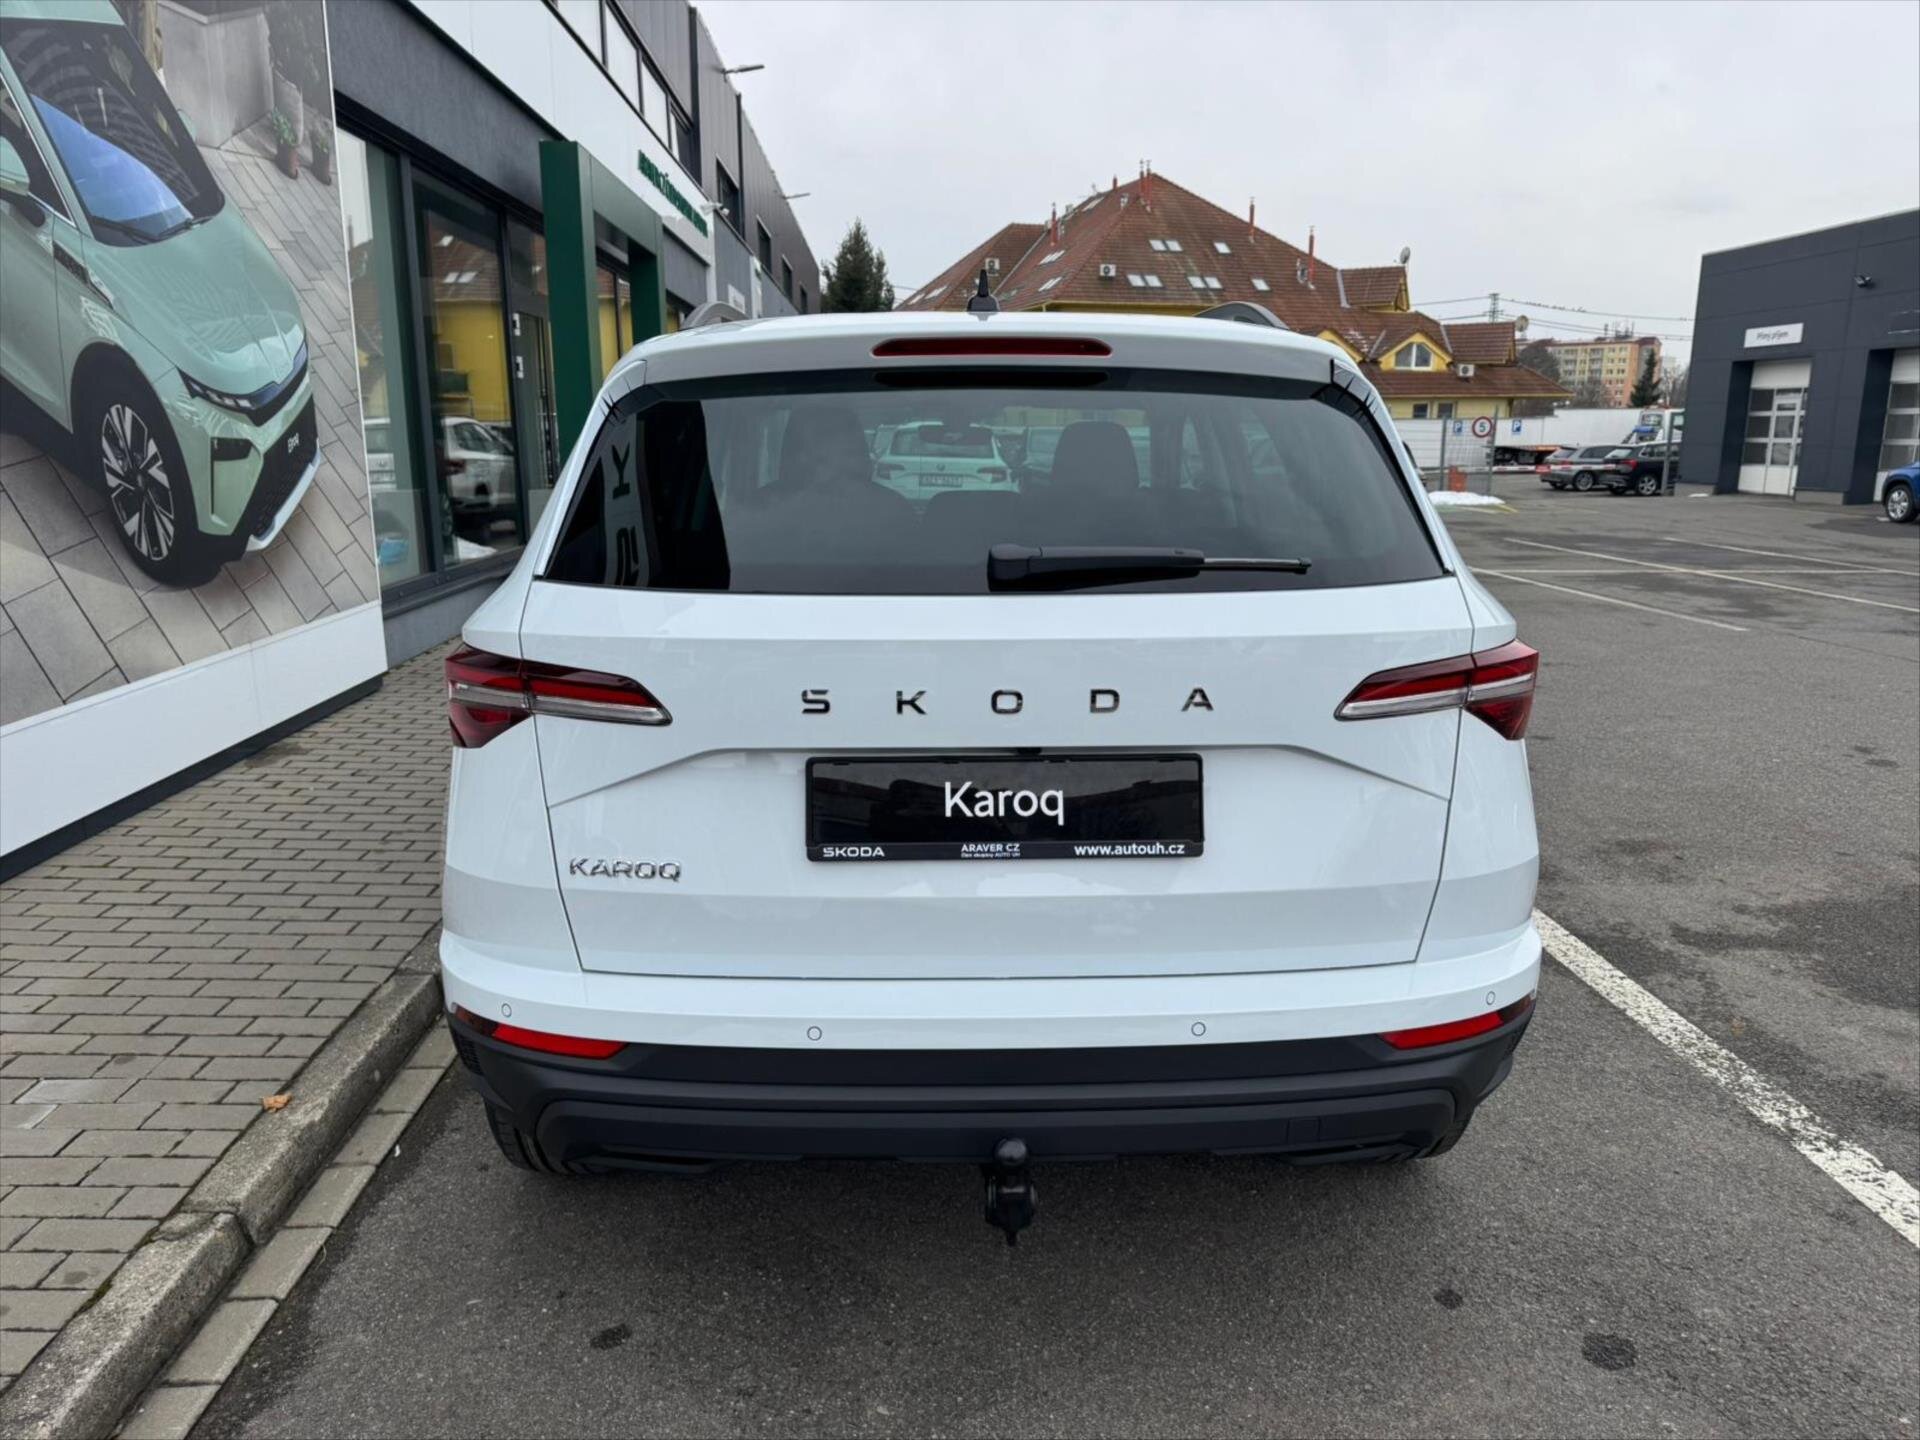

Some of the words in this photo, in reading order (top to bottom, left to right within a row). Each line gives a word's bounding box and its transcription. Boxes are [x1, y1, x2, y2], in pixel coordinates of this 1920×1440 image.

[1479, 422, 1486, 432] 5
[801, 687, 1214, 715] SKODA
[944, 781, 1065, 826] Karoq
[823, 846, 885, 858] SKODA
[961, 843, 1003, 852] ARAVER
[1006, 843, 1020, 852] CZ
[1073, 844, 1186, 856] www.autouh.cz
[569, 857, 681, 882] KAROQ
